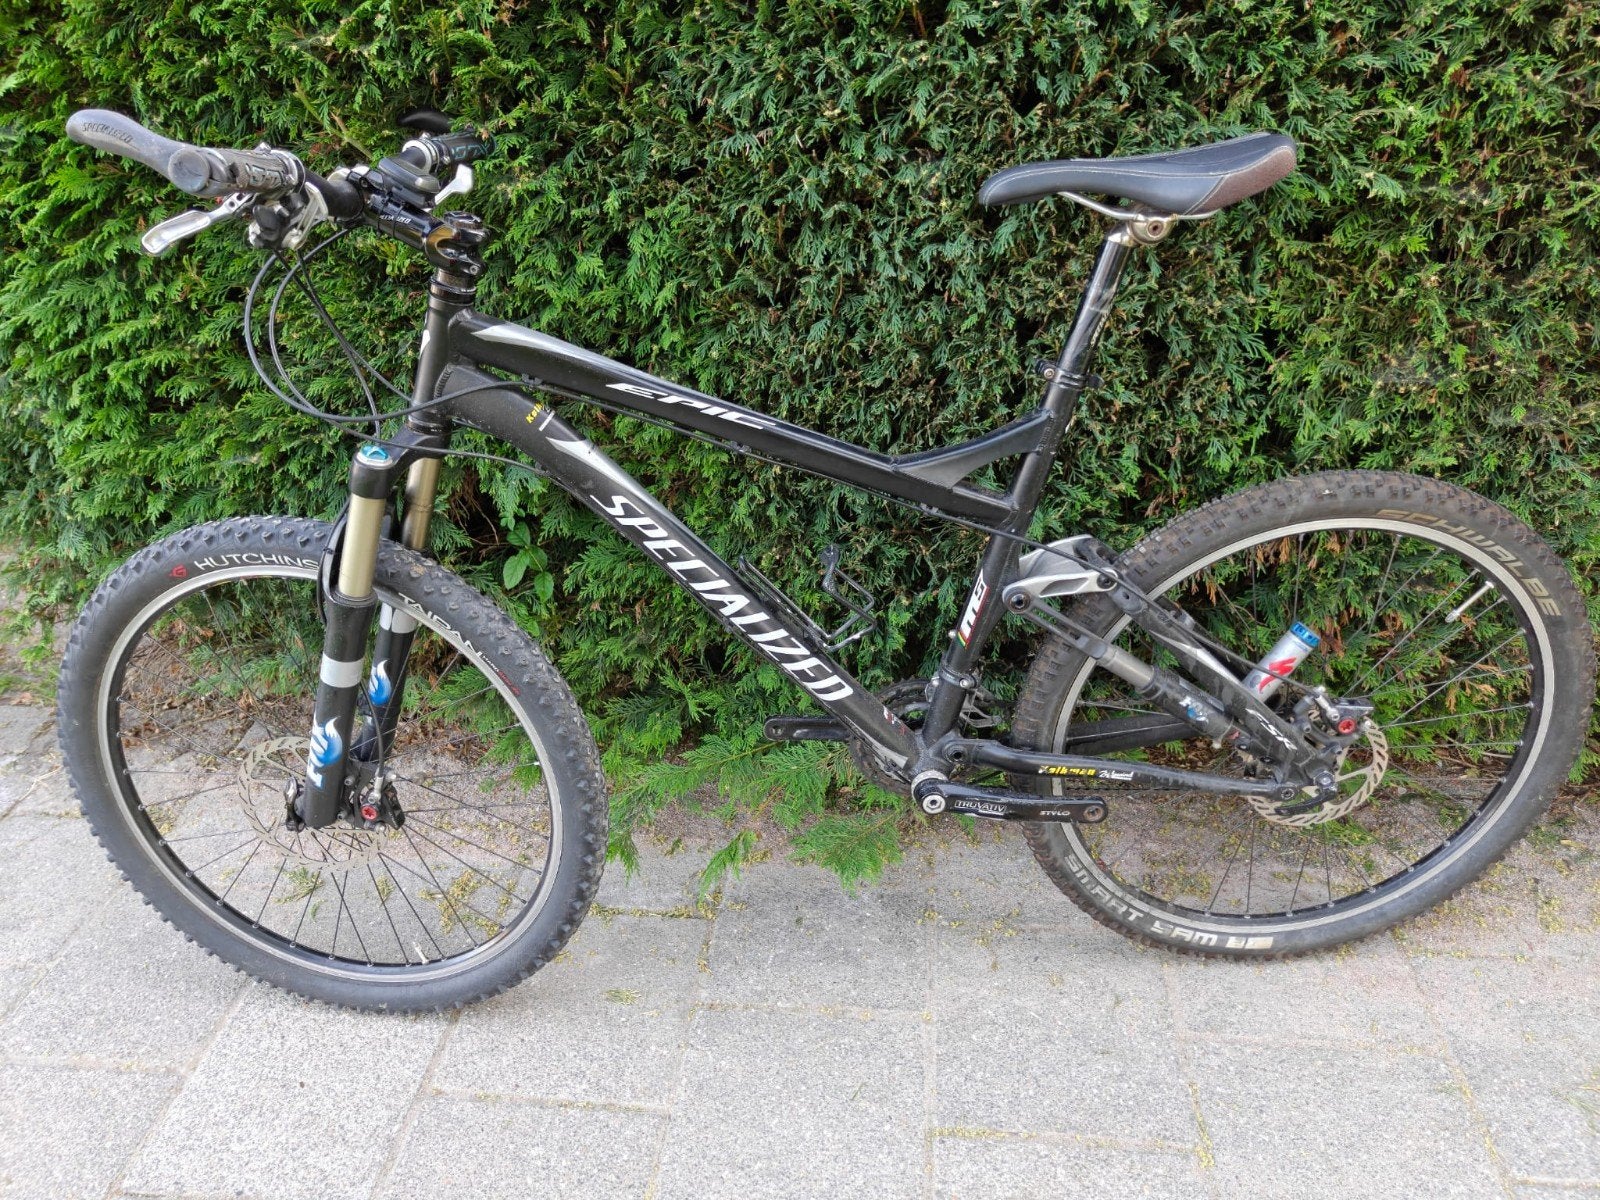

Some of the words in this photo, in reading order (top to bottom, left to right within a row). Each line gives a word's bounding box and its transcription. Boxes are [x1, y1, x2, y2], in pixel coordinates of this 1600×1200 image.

[605, 383, 777, 430] EPIC
[589, 495, 854, 701] SPECIALIZED
[1375, 508, 1562, 617] SCHWALBE
[955, 801, 1006, 814] TRUVATIV
[1064, 854, 1144, 921] SMART
[1150, 920, 1218, 946] SAM
